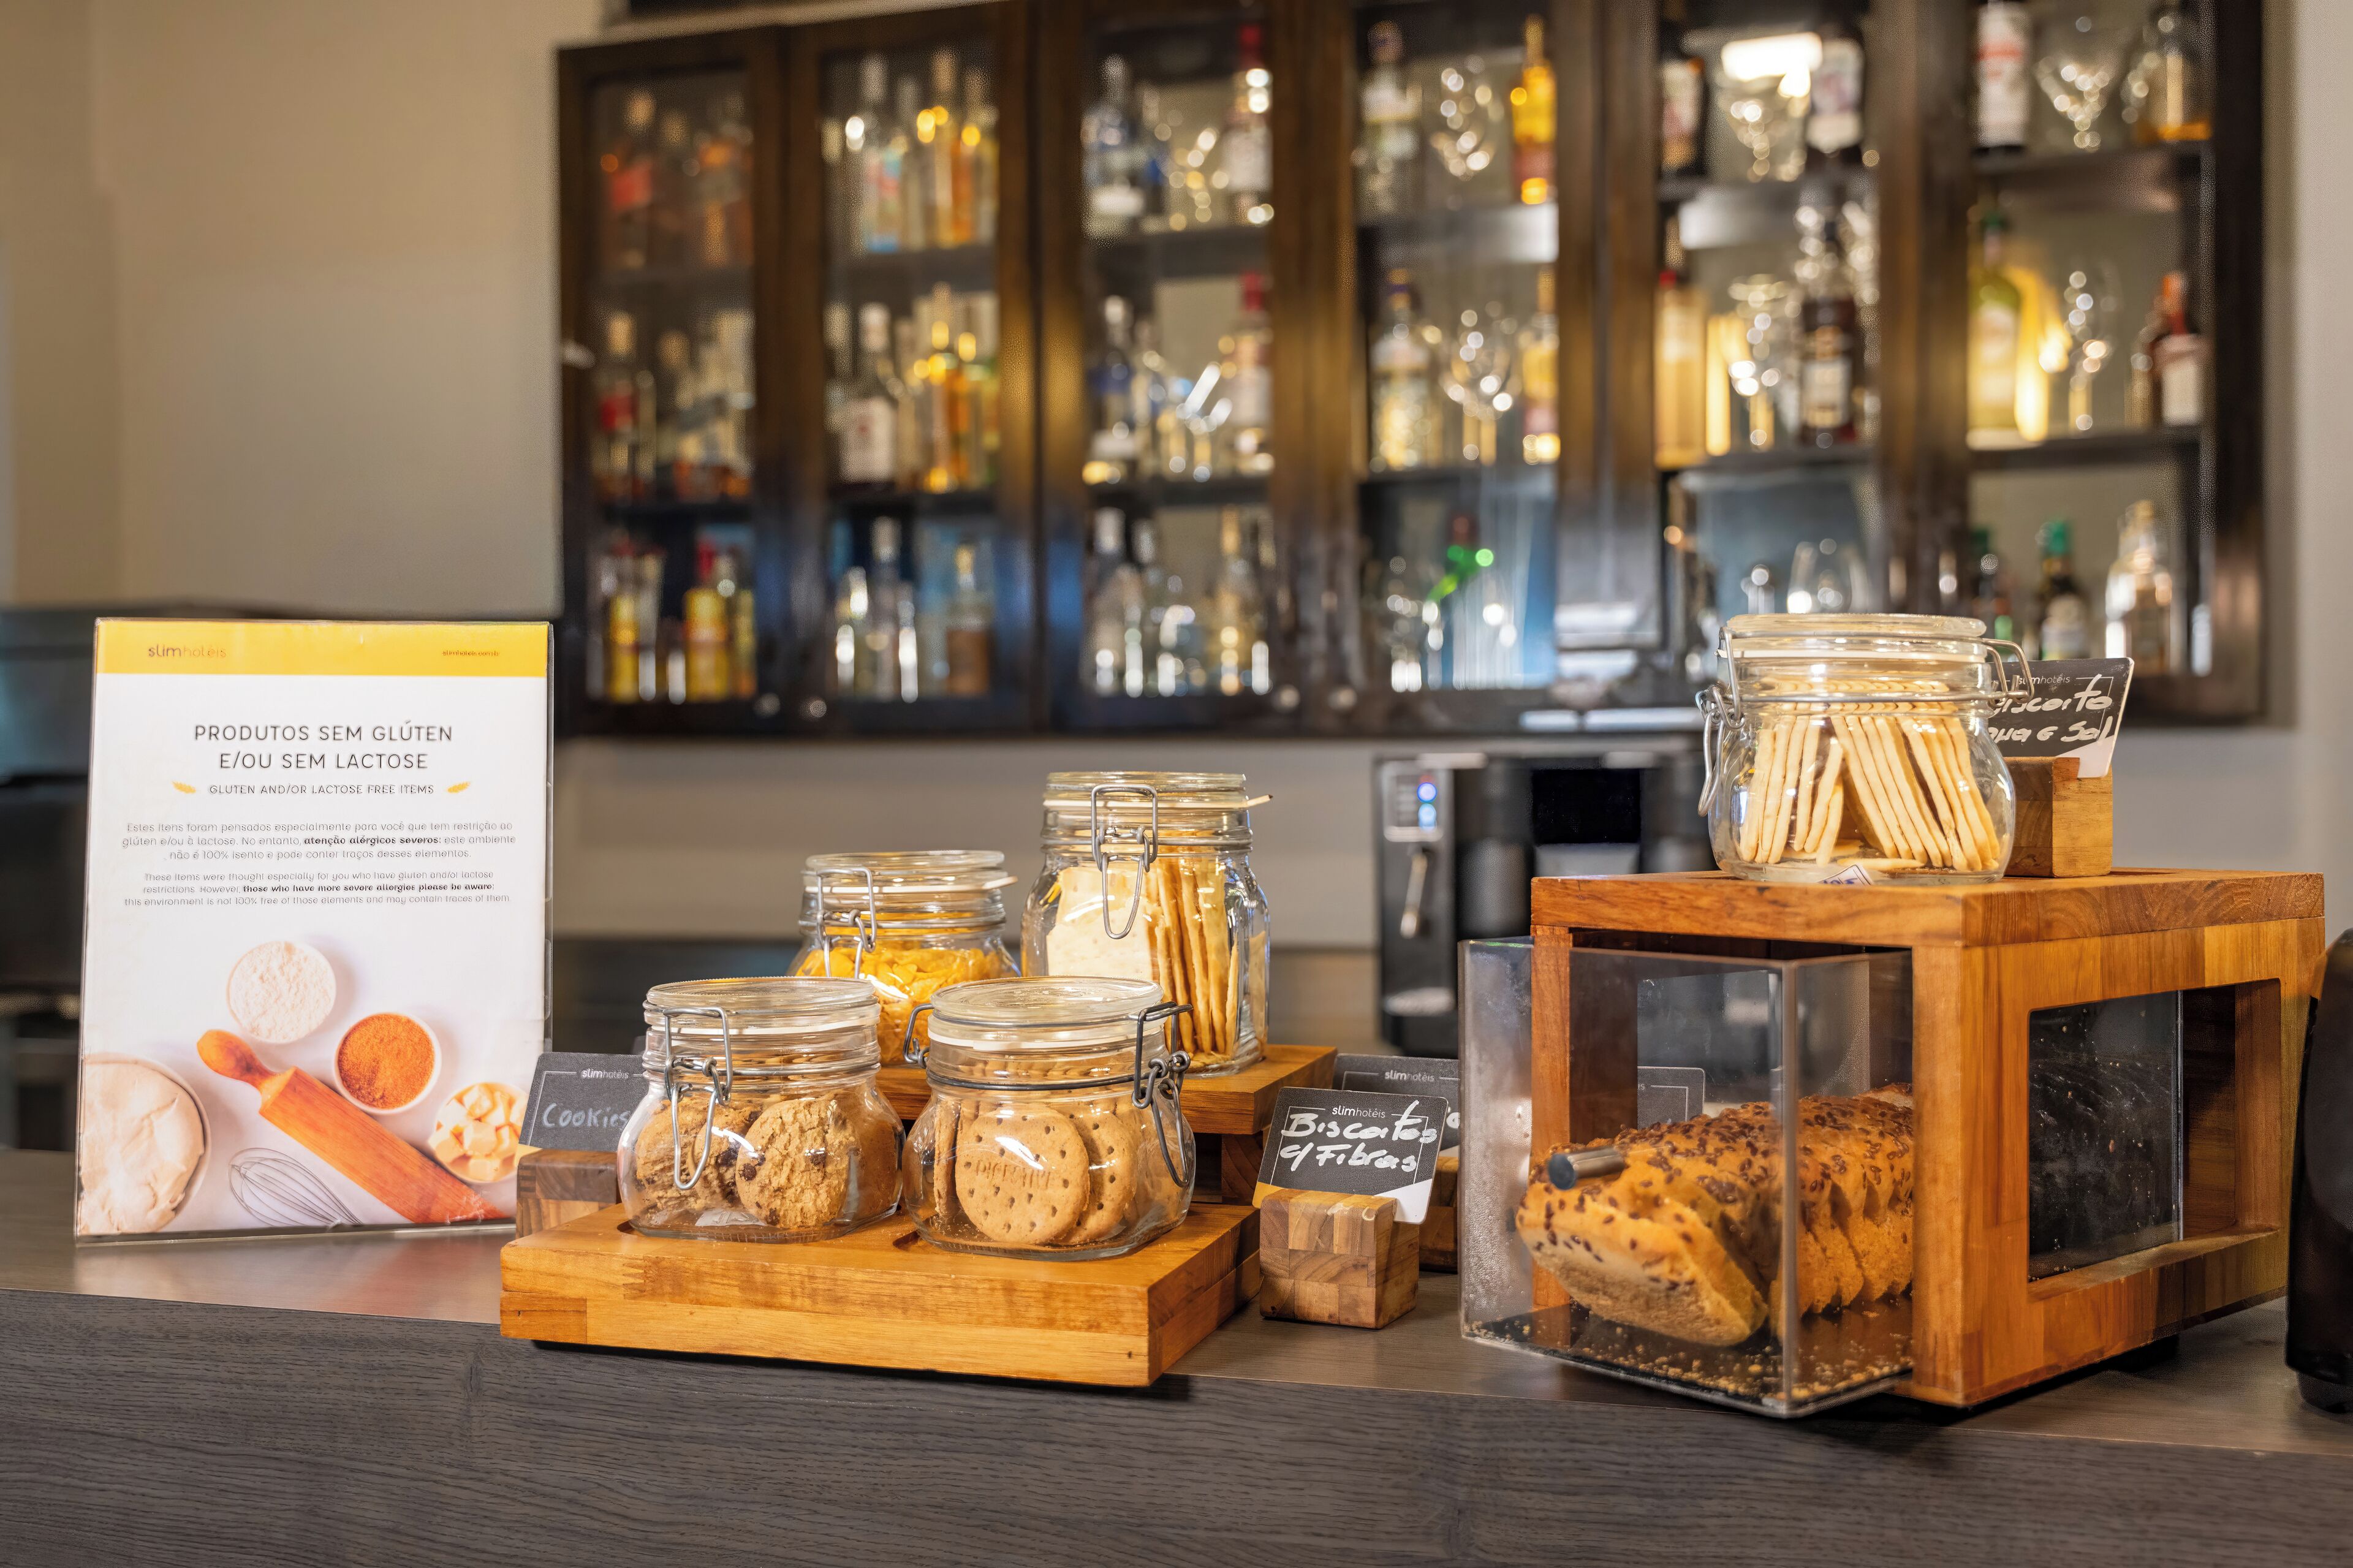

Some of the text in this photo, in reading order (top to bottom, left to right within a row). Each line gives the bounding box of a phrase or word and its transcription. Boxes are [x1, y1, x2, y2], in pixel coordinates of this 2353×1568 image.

[194, 719, 452, 742] PRODUTOS SEM GLÚTEN
[219, 751, 428, 770] E/OU SEM LACTOSE
[208, 783, 434, 795] GLUTEN AND/OR LACTOSE FREE ITEMS
[127, 820, 513, 834] Estes itens foram pensados especialmente para você que tem restrição ao
[122, 836, 157, 849] glúten
[161, 836, 184, 847] e/ou
[187, 835, 194, 847] à
[241, 836, 256, 848] No
[304, 835, 346, 847] atenção
[349, 835, 396, 847] alérgicos
[444, 836, 465, 845] este
[469, 835, 516, 844] ambiente
[169, 849, 190, 860] não
[193, 849, 200, 860] é
[203, 850, 229, 860] 100%
[232, 850, 264, 860] isento
[267, 851, 273, 860] e
[277, 849, 303, 861] pode
[306, 850, 338, 859] conter
[343, 850, 374, 862] traços
[377, 849, 412, 858] desses
[144, 873, 172, 882] These
[175, 872, 200, 883] items
[203, 873, 226, 882] were
[229, 872, 264, 883] thought
[267, 872, 314, 882] especially
[317, 872, 328, 881] for
[332, 873, 349, 882] you
[374, 871, 396, 880] have
[398, 871, 427, 881] gluten
[430, 870, 458, 879] and/or
[461, 870, 494, 879] lactose
[243, 884, 268, 893] those
[270, 884, 290, 893] who
[292, 884, 314, 893] have
[317, 884, 341, 892] more
[343, 884, 373, 893] severe
[376, 882, 415, 894] allergies
[419, 882, 448, 893] please
[452, 882, 462, 892] be
[124, 897, 142, 907] this
[145, 898, 203, 907] environment
[207, 898, 214, 906] is
[217, 896, 232, 906] not
[235, 896, 257, 907] 100%
[260, 896, 278, 906] free
[281, 896, 290, 906] of
[293, 896, 319, 906] those
[321, 896, 363, 907] elements
[366, 895, 383, 904] and
[387, 896, 406, 906] may
[475, 894, 484, 903] of
[542, 1102, 631, 1130] Cookies
[1332, 1105, 1386, 1118] slimhotéis
[1316, 1142, 1418, 1173] Fibras
